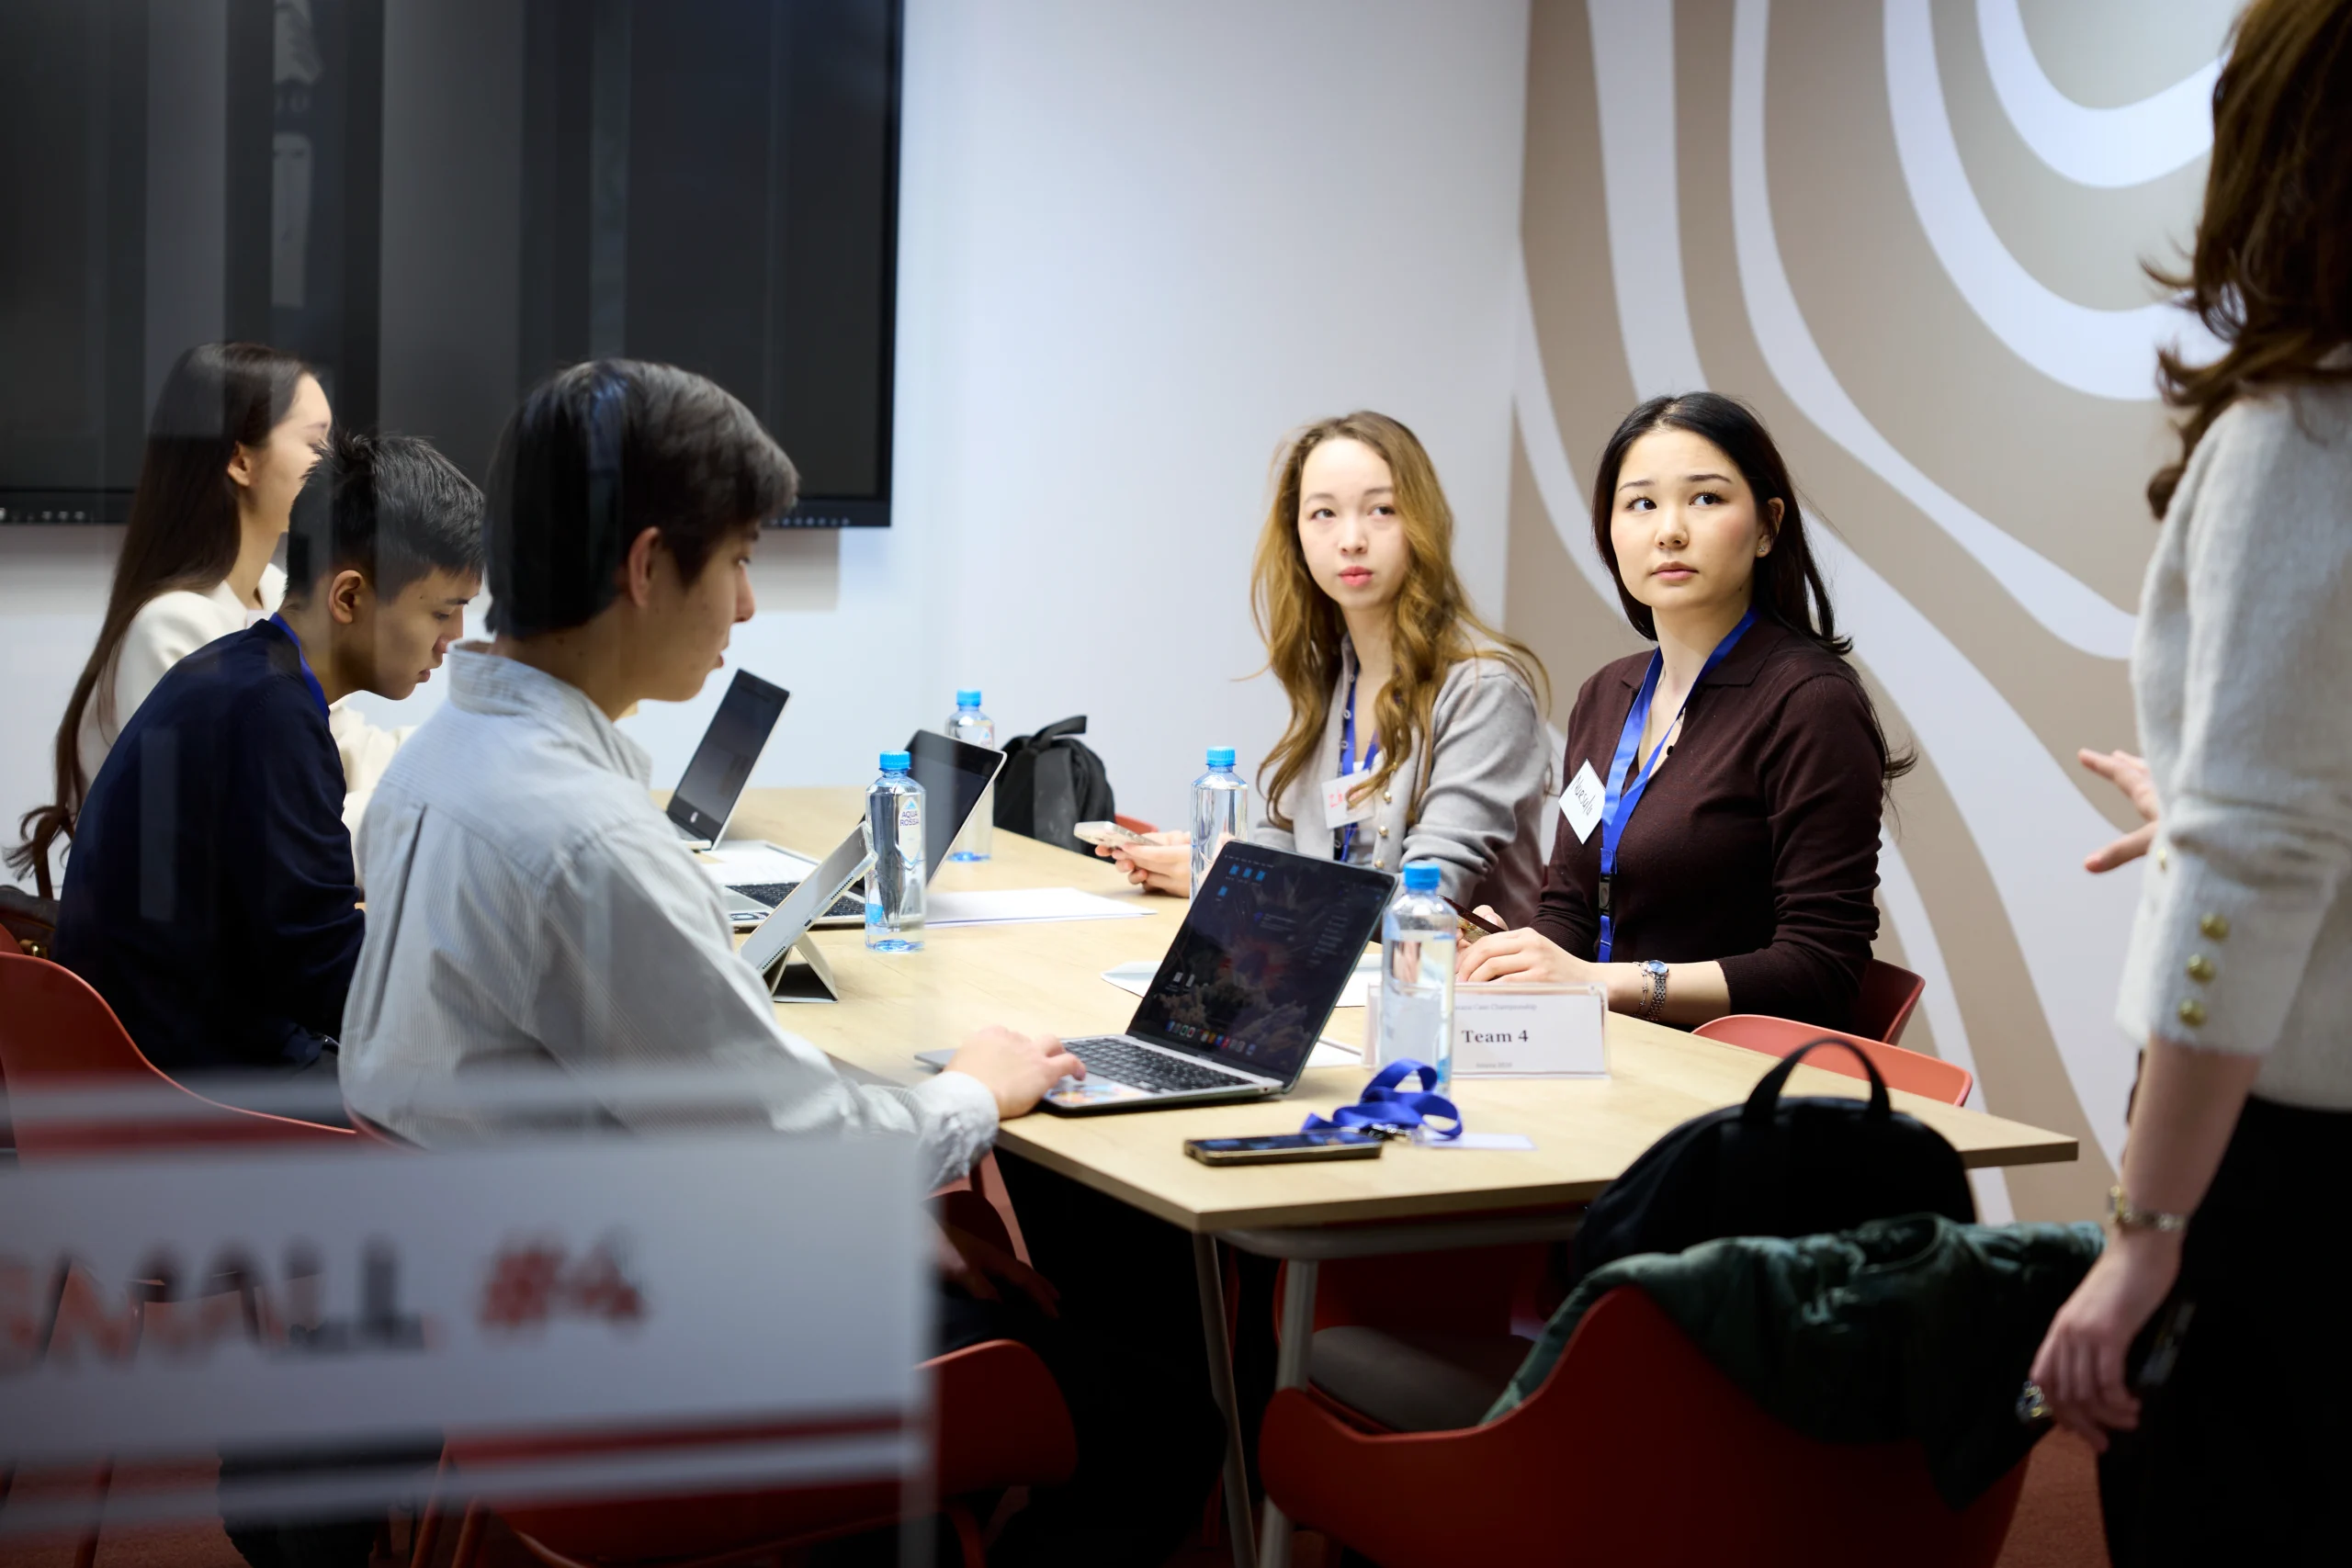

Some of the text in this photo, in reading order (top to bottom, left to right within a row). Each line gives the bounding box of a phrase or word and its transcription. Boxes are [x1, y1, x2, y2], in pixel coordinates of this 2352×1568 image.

[902, 810, 918, 818] AQUA
[1461, 1029, 1529, 1043] Team 4
